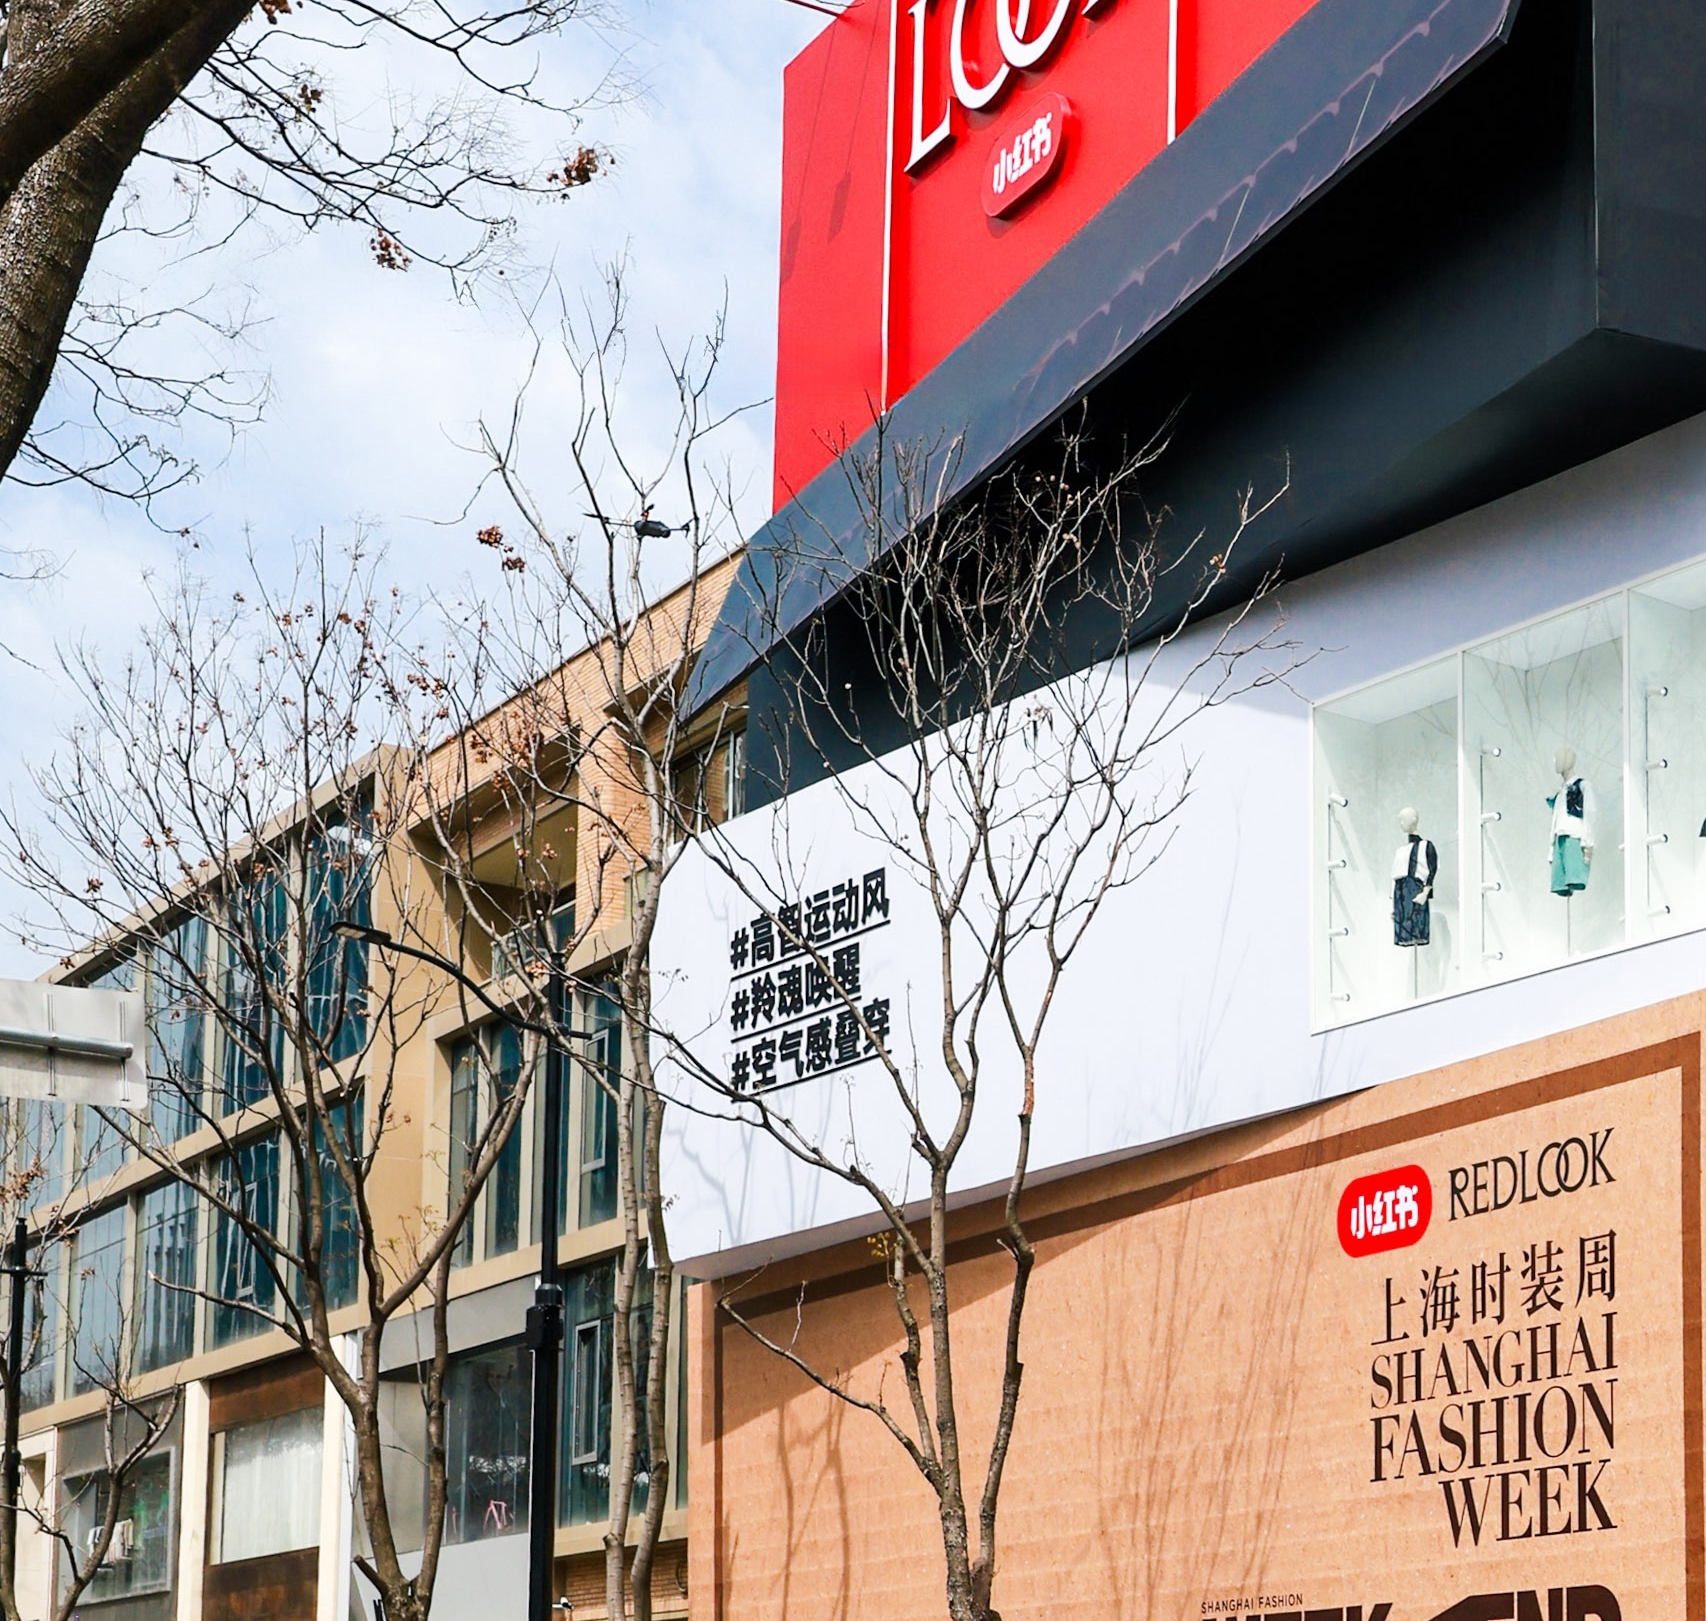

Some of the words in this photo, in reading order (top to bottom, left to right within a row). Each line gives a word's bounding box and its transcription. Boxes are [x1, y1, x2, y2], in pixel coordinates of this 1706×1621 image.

[992, 111, 1053, 195] 小红书
[1351, 1184, 1418, 1240] 小红书
[1448, 1127, 1617, 1222] REDLOOK
[1370, 1228, 1617, 1347] 上海时装周
[1370, 1311, 1618, 1410] SHANGHAI
[1369, 1378, 1619, 1483] FASHION
[1438, 1458, 1618, 1549] WEEK
[1201, 1598, 1254, 1614] SHANGHAI
[1258, 1593, 1303, 1609] FASHION
